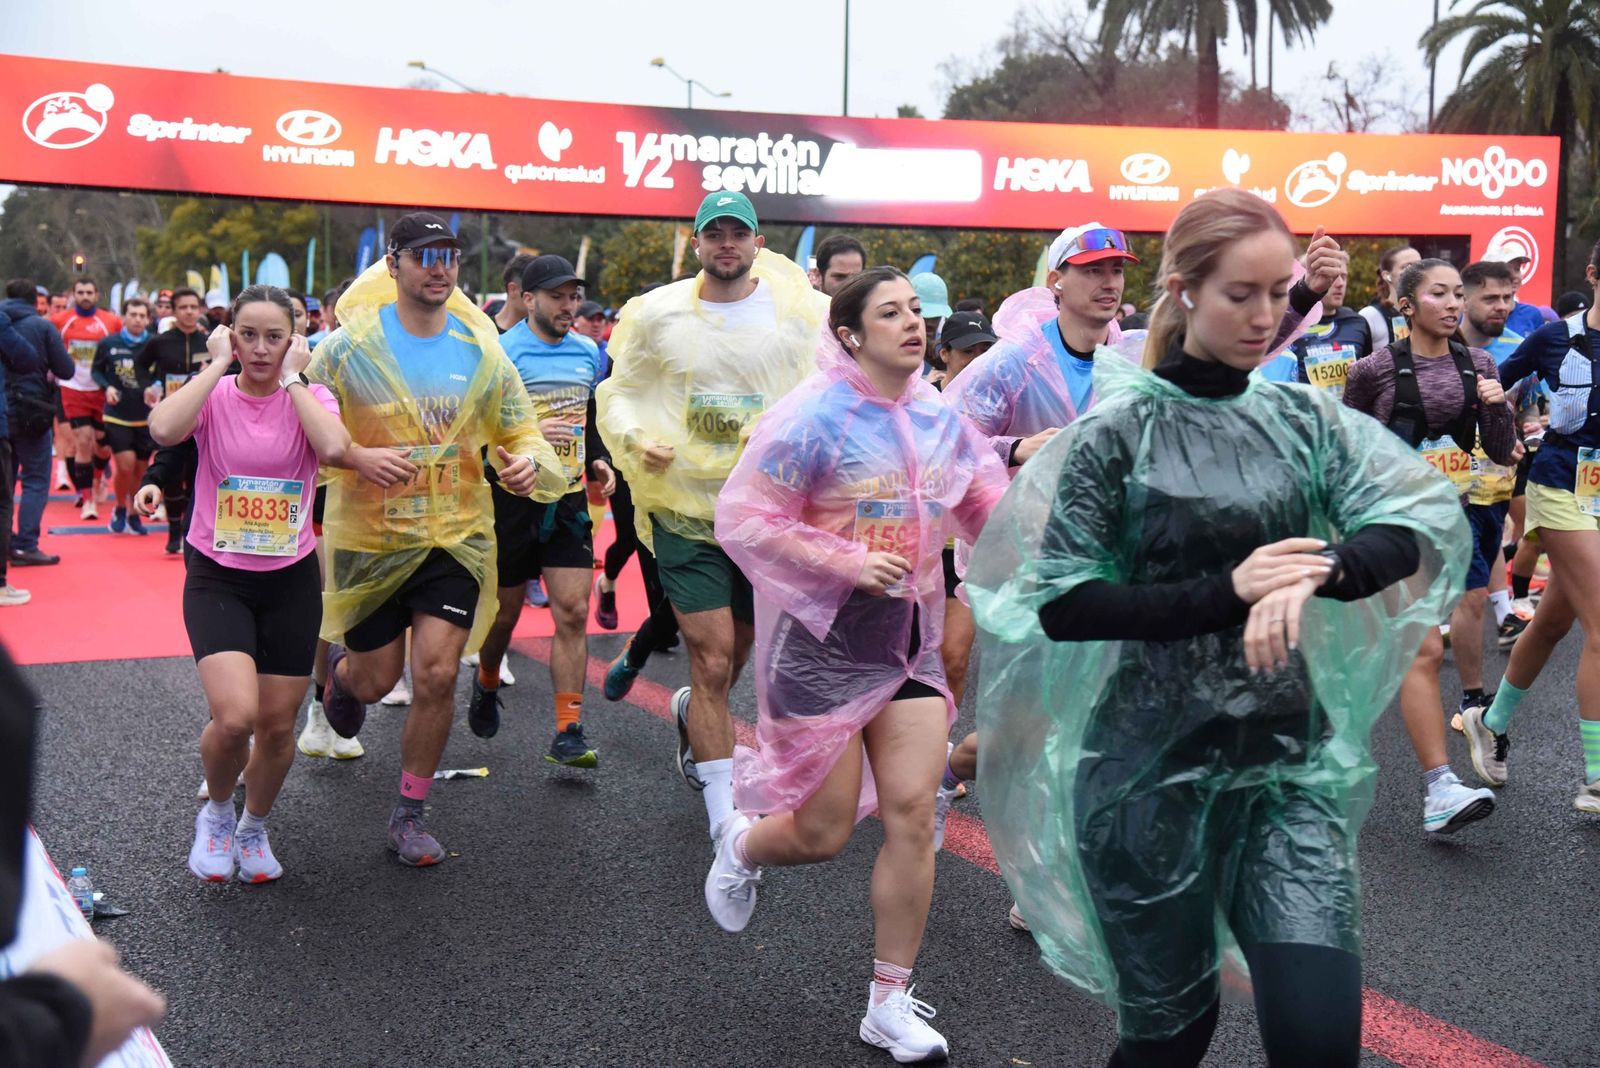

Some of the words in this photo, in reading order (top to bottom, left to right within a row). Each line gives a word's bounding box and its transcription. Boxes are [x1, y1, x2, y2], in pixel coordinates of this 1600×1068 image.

[127, 113, 251, 143] Sprinter
[263, 145, 354, 166] HYUNDAI
[375, 127, 497, 170] HOKA
[701, 162, 828, 196] sevilla
[994, 157, 1093, 192] HOKA
[1347, 169, 1438, 195] Sprinter
[1110, 185, 1179, 202] HYUNDAI
[224, 495, 289, 522] 13833
